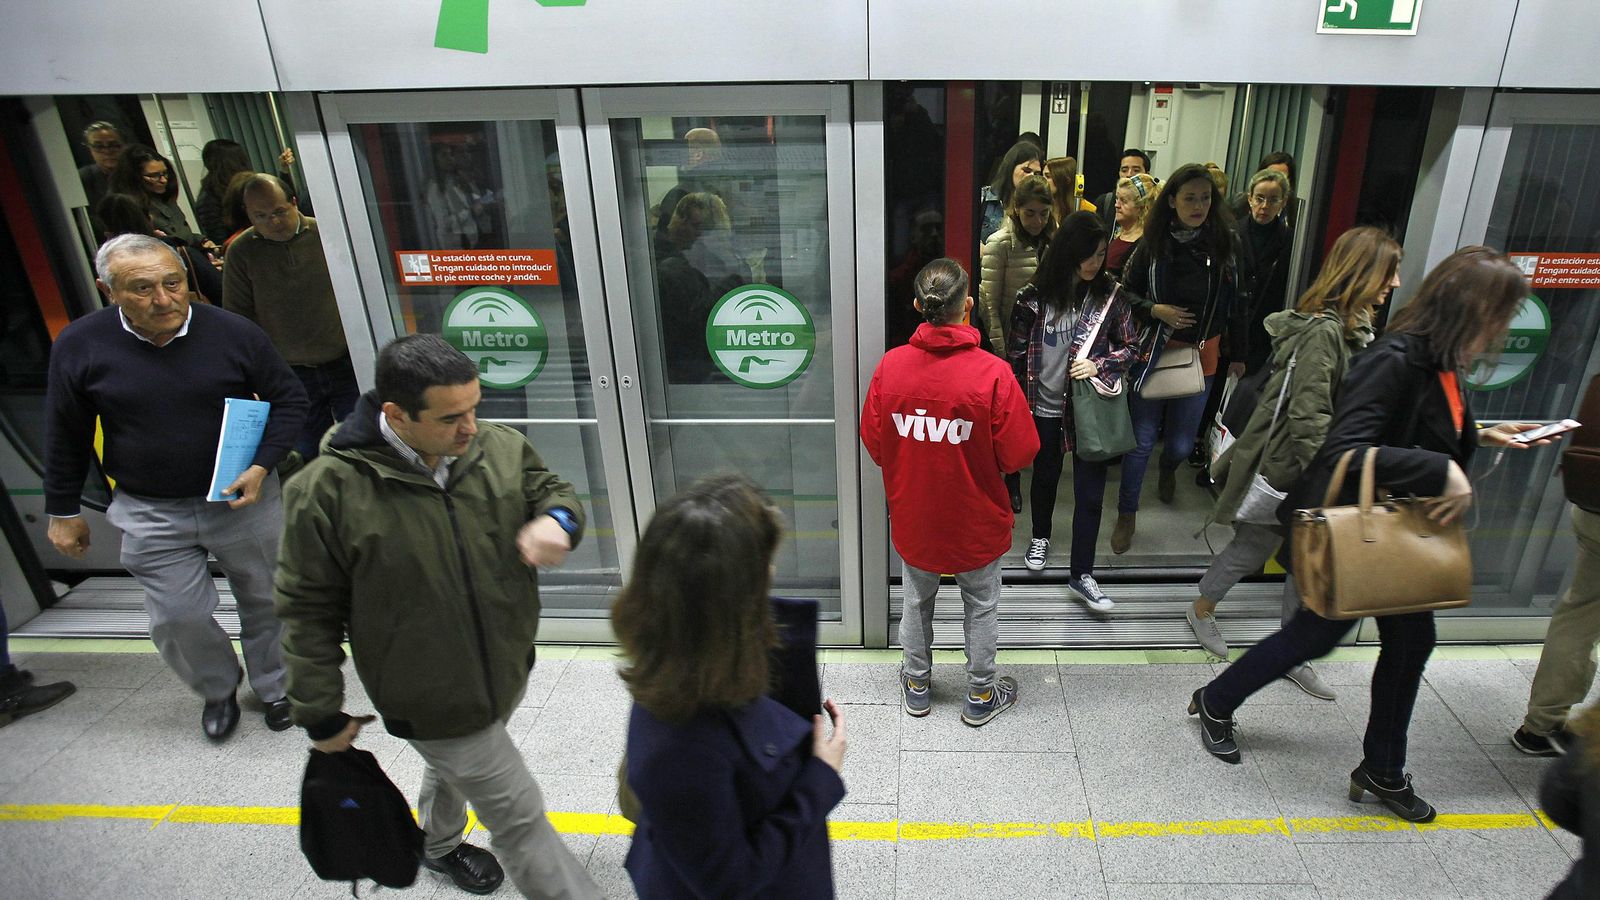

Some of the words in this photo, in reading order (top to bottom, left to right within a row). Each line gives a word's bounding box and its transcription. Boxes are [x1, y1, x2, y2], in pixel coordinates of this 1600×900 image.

[431, 254, 441, 262] La
[442, 253, 476, 262] estación
[477, 253, 495, 262] está
[432, 264, 464, 274] Tengan
[465, 263, 498, 271] cuidado
[499, 264, 511, 272] no
[512, 263, 553, 271] introducir
[1538, 266, 1569, 276] Tengan
[434, 274, 443, 282] el
[444, 274, 457, 283] pie
[458, 274, 480, 282] entre
[480, 273, 505, 281] coche
[506, 275, 512, 283] y
[513, 273, 542, 281] andén.
[1535, 276, 1543, 284] el
[1543, 277, 1557, 285] pie
[462, 330, 529, 347] Metro
[726, 329, 796, 346] Metro
[891, 408, 974, 445] viva
